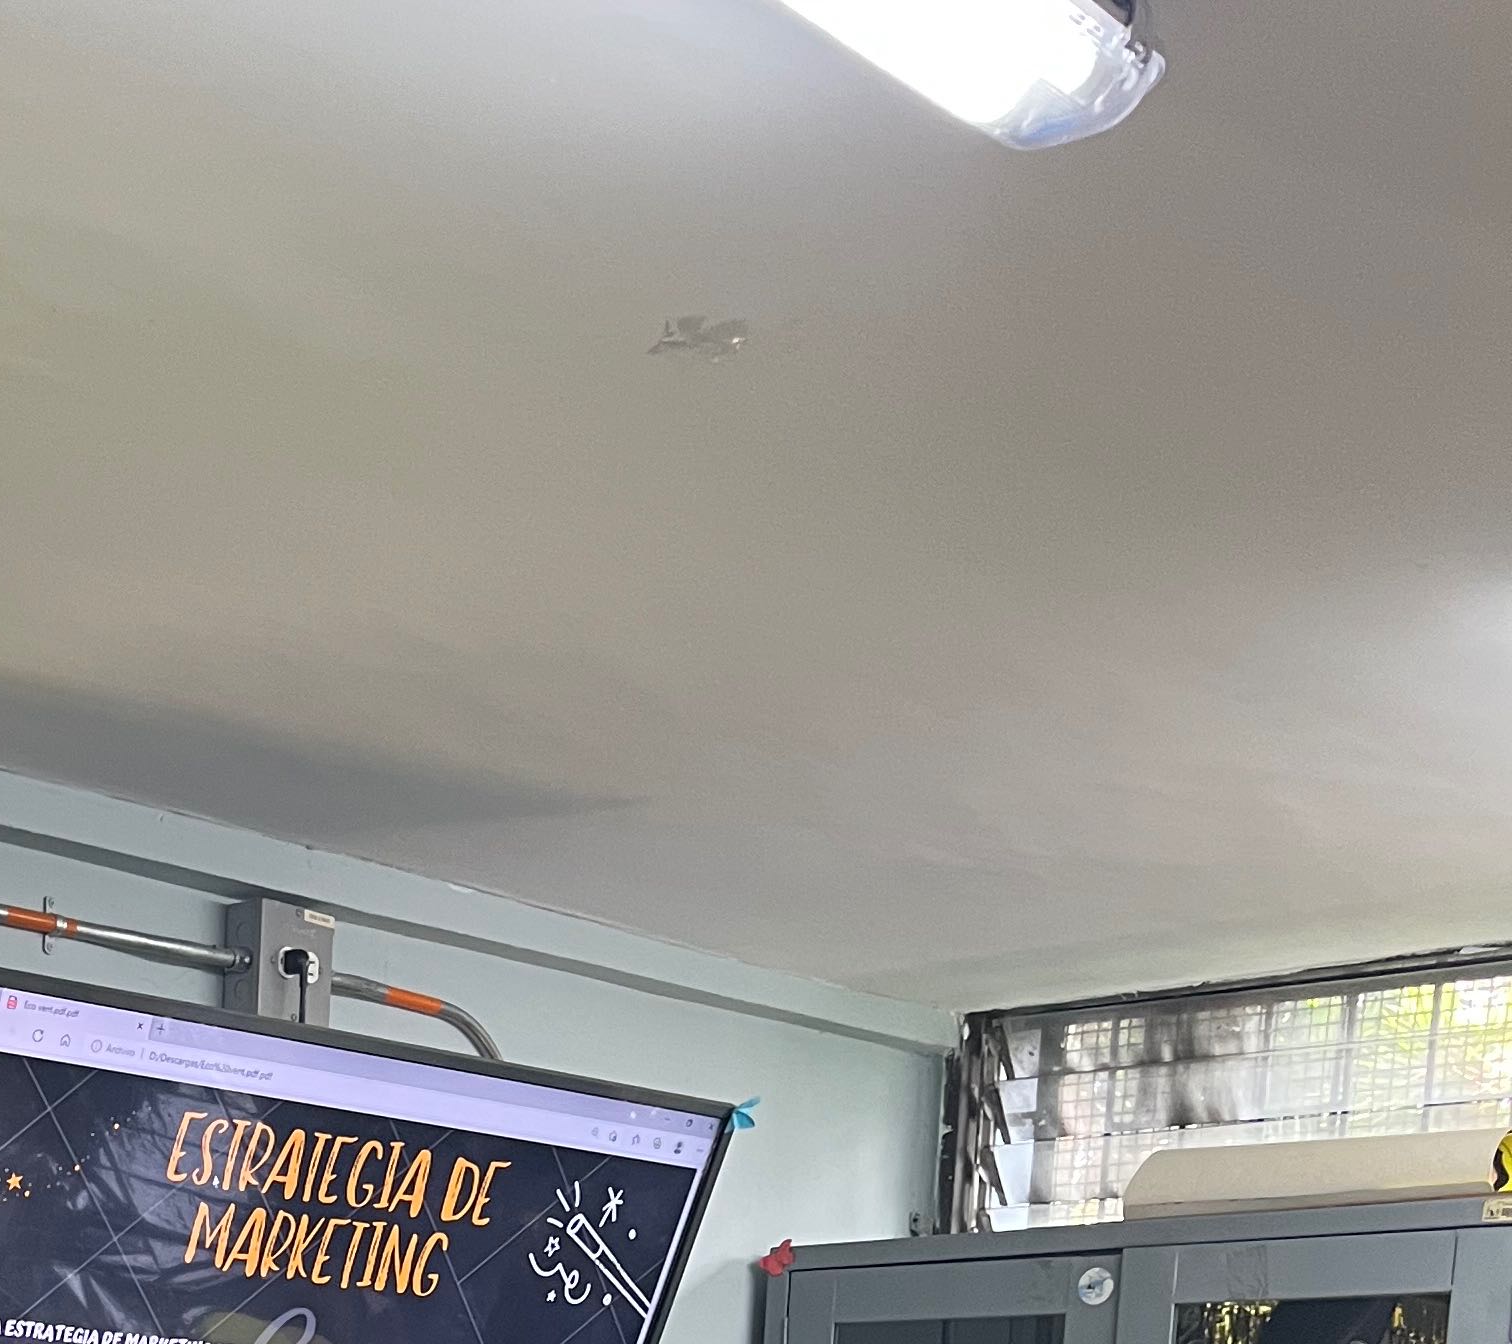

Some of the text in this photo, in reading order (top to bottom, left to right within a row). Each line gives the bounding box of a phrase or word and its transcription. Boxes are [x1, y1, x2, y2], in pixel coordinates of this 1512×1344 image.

[166, 1111, 512, 1226] ESTRATEGIA DE
[184, 1201, 449, 1297] MARKETING
